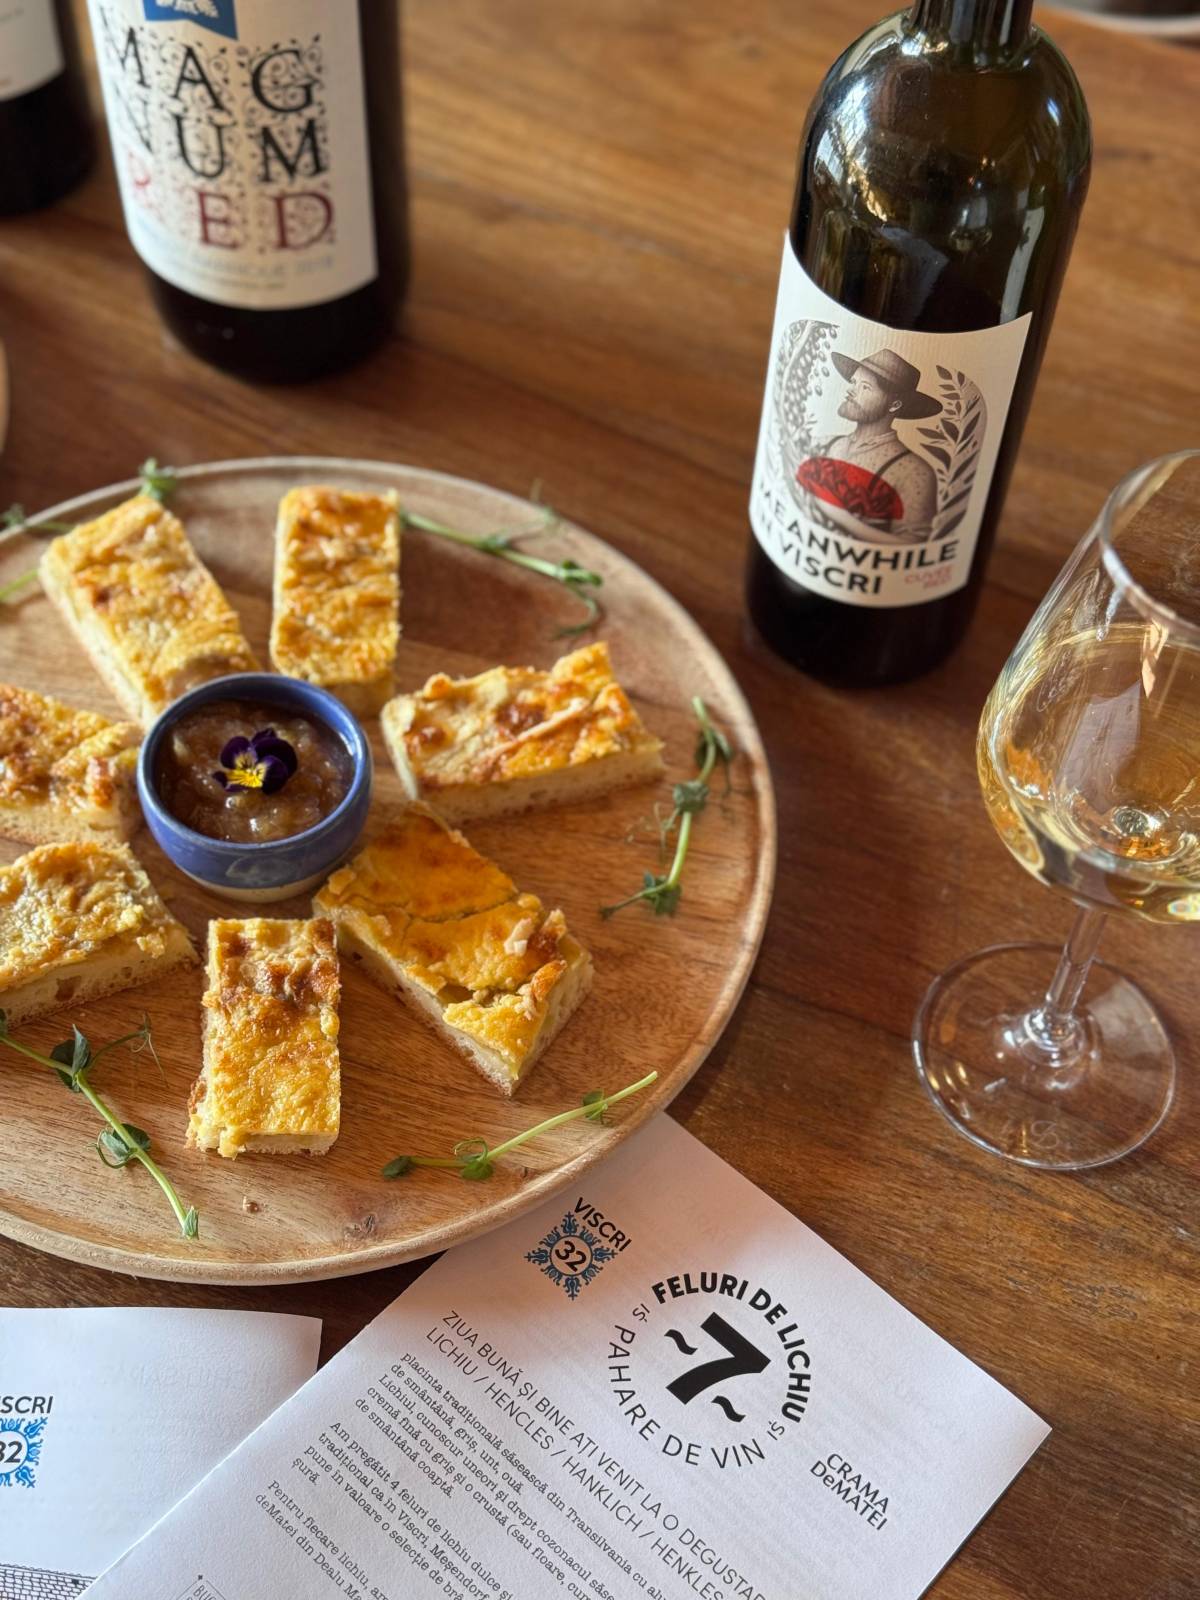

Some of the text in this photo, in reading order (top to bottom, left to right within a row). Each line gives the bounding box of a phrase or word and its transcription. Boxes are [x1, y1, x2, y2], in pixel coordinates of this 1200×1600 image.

[779, 531, 882, 595] VISCRI
[555, 1241, 586, 1272] 32
[574, 1197, 631, 1251] VISCRI
[608, 1325, 765, 1469] PAHARE DE VIN
[652, 1272, 749, 1304] FELURI
[748, 1288, 788, 1325] DE
[777, 1323, 811, 1423] LICHIU
[665, 1311, 771, 1405] 7
[0, 1396, 53, 1413] SCRI
[355, 1399, 454, 1499] de smântână coaptă.
[391, 1365, 405, 1378] de
[404, 1377, 456, 1430] smântână,
[454, 1428, 478, 1453] griș,
[479, 1449, 499, 1475] unt,
[426, 1327, 478, 1376] LICHIU
[484, 1382, 554, 1450] HENCLES
[562, 1456, 643, 1532] HANKLICH
[442, 1310, 479, 1348] ZIUA
[477, 1342, 524, 1387] BUNĂ
[517, 1382, 538, 1401] ȘI
[535, 1396, 575, 1436] BINE
[569, 1432, 599, 1458] AȚI
[597, 1452, 645, 1496] VENIT
[640, 1493, 662, 1519] LA
[662, 1514, 679, 1531] O
[303, 1445, 333, 1473] pune
[344, 1482, 382, 1523] valoare
[389, 1530, 429, 1571] selecție
[428, 1569, 443, 1585] de
[318, 1432, 374, 1488] tradițional
[371, 1487, 384, 1502] ca
[398, 1509, 429, 1549] Viscri,
[329, 1422, 350, 1442] Am
[347, 1440, 391, 1482] pregătit
[397, 1488, 429, 1520] feluri
[426, 1518, 441, 1533] de
[439, 1529, 471, 1564] lichiu
[471, 1561, 501, 1591] dulce
[367, 1387, 401, 1420] cremă
[419, 1439, 434, 1454] cu
[431, 1452, 455, 1476] griș
[452, 1473, 467, 1485] și
[472, 1491, 509, 1527] crustă
[506, 1524, 532, 1550] (sau
[531, 1547, 565, 1585] floare,
[378, 1373, 416, 1415] Lichiul,
[462, 1456, 498, 1492] uneori
[495, 1490, 509, 1503] și
[507, 1501, 537, 1531] drept
[537, 1529, 592, 1582] cozonacul
[400, 1353, 443, 1394] placinta
[442, 1390, 504, 1451] tradițională
[501, 1448, 549, 1494] săsească
[547, 1492, 565, 1512] din
[566, 1507, 632, 1575] Transilvania
[632, 1572, 647, 1589] cu
[810, 1460, 888, 1531] DeMATEI
[827, 1453, 889, 1514] CRAMA
[255, 1495, 298, 1538] deMatei
[295, 1536, 314, 1556] din
[313, 1552, 345, 1587] Dealu
[268, 1480, 304, 1520] Pentru
[302, 1516, 339, 1555] fiecare
[338, 1552, 369, 1590] lichiu,
